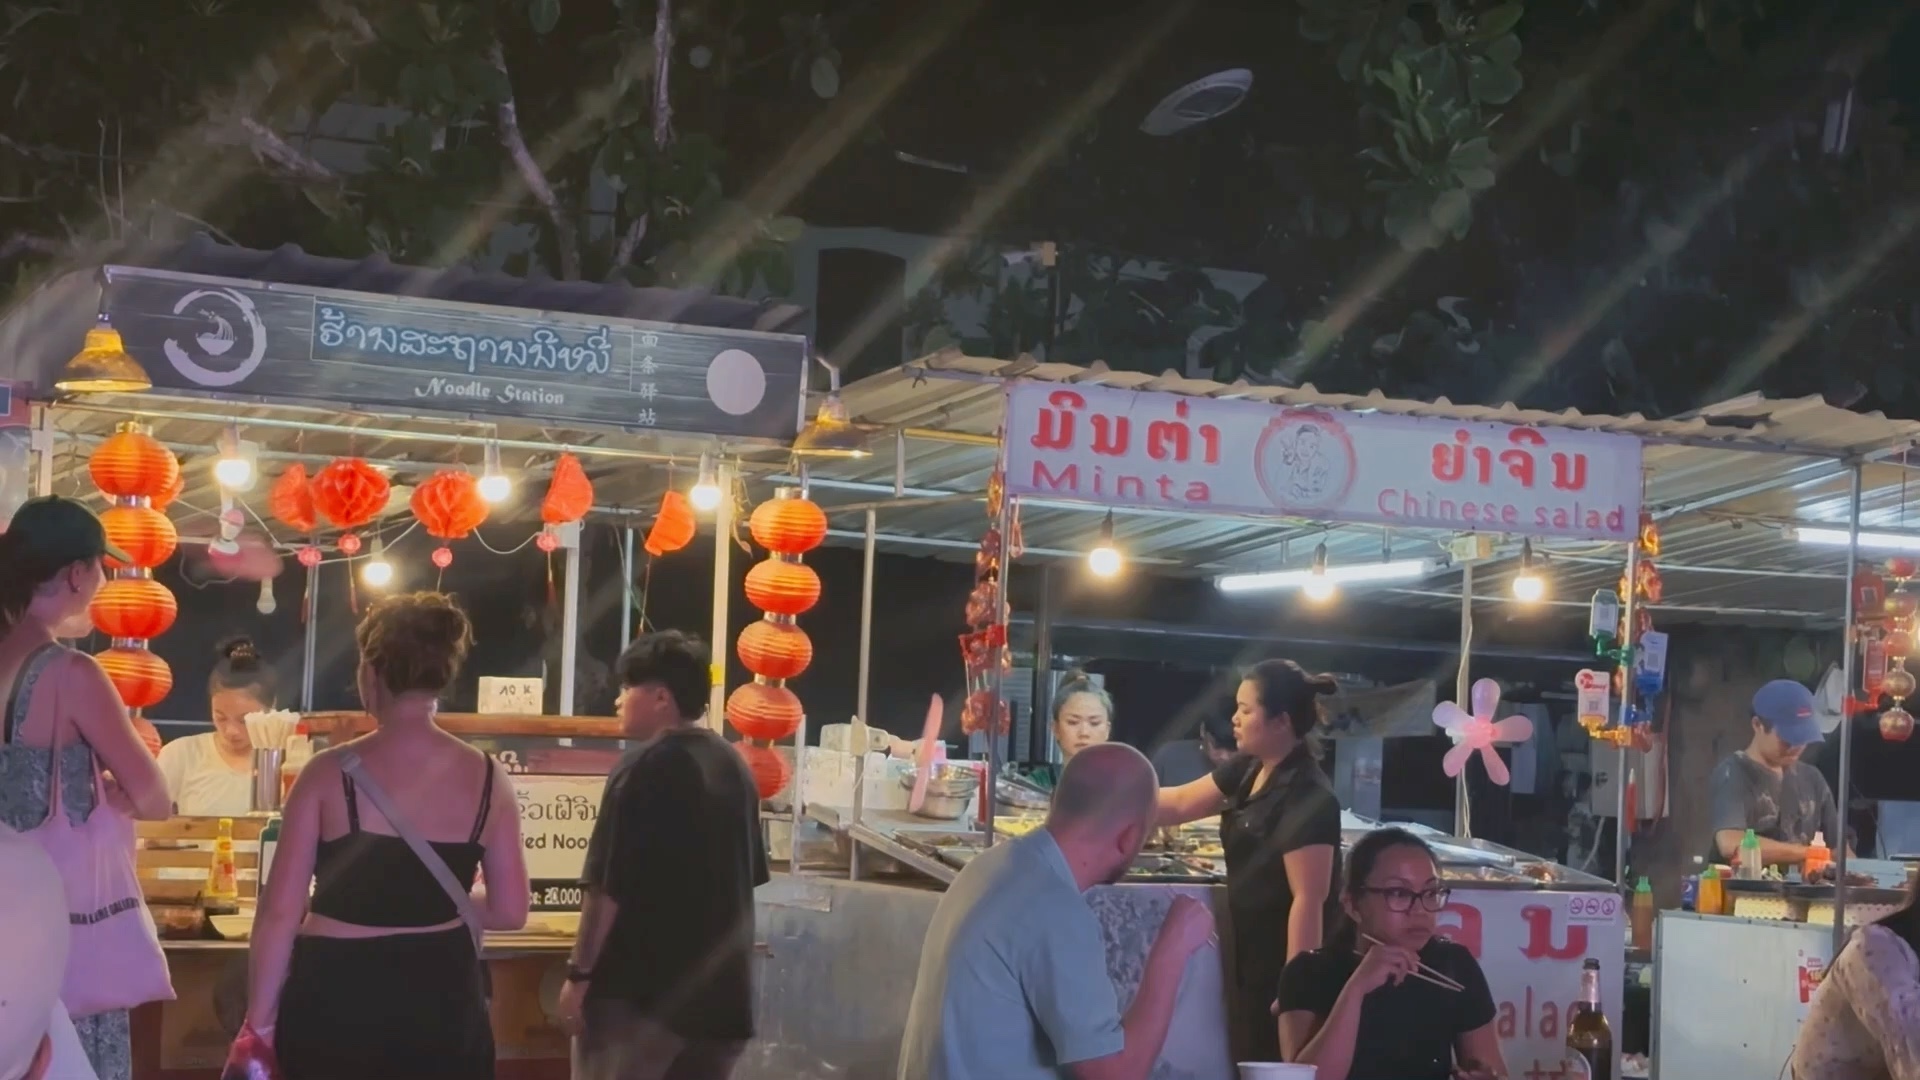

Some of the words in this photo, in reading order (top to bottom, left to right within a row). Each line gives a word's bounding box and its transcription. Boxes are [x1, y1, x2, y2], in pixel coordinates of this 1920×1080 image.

[415, 377, 491, 398] Noodle
[496, 384, 564, 404] Station
[1032, 460, 1210, 502] Minta
[1377, 488, 1518, 524] Chinese
[1534, 501, 1625, 532] salad
[499, 684, 516, 696] 10
